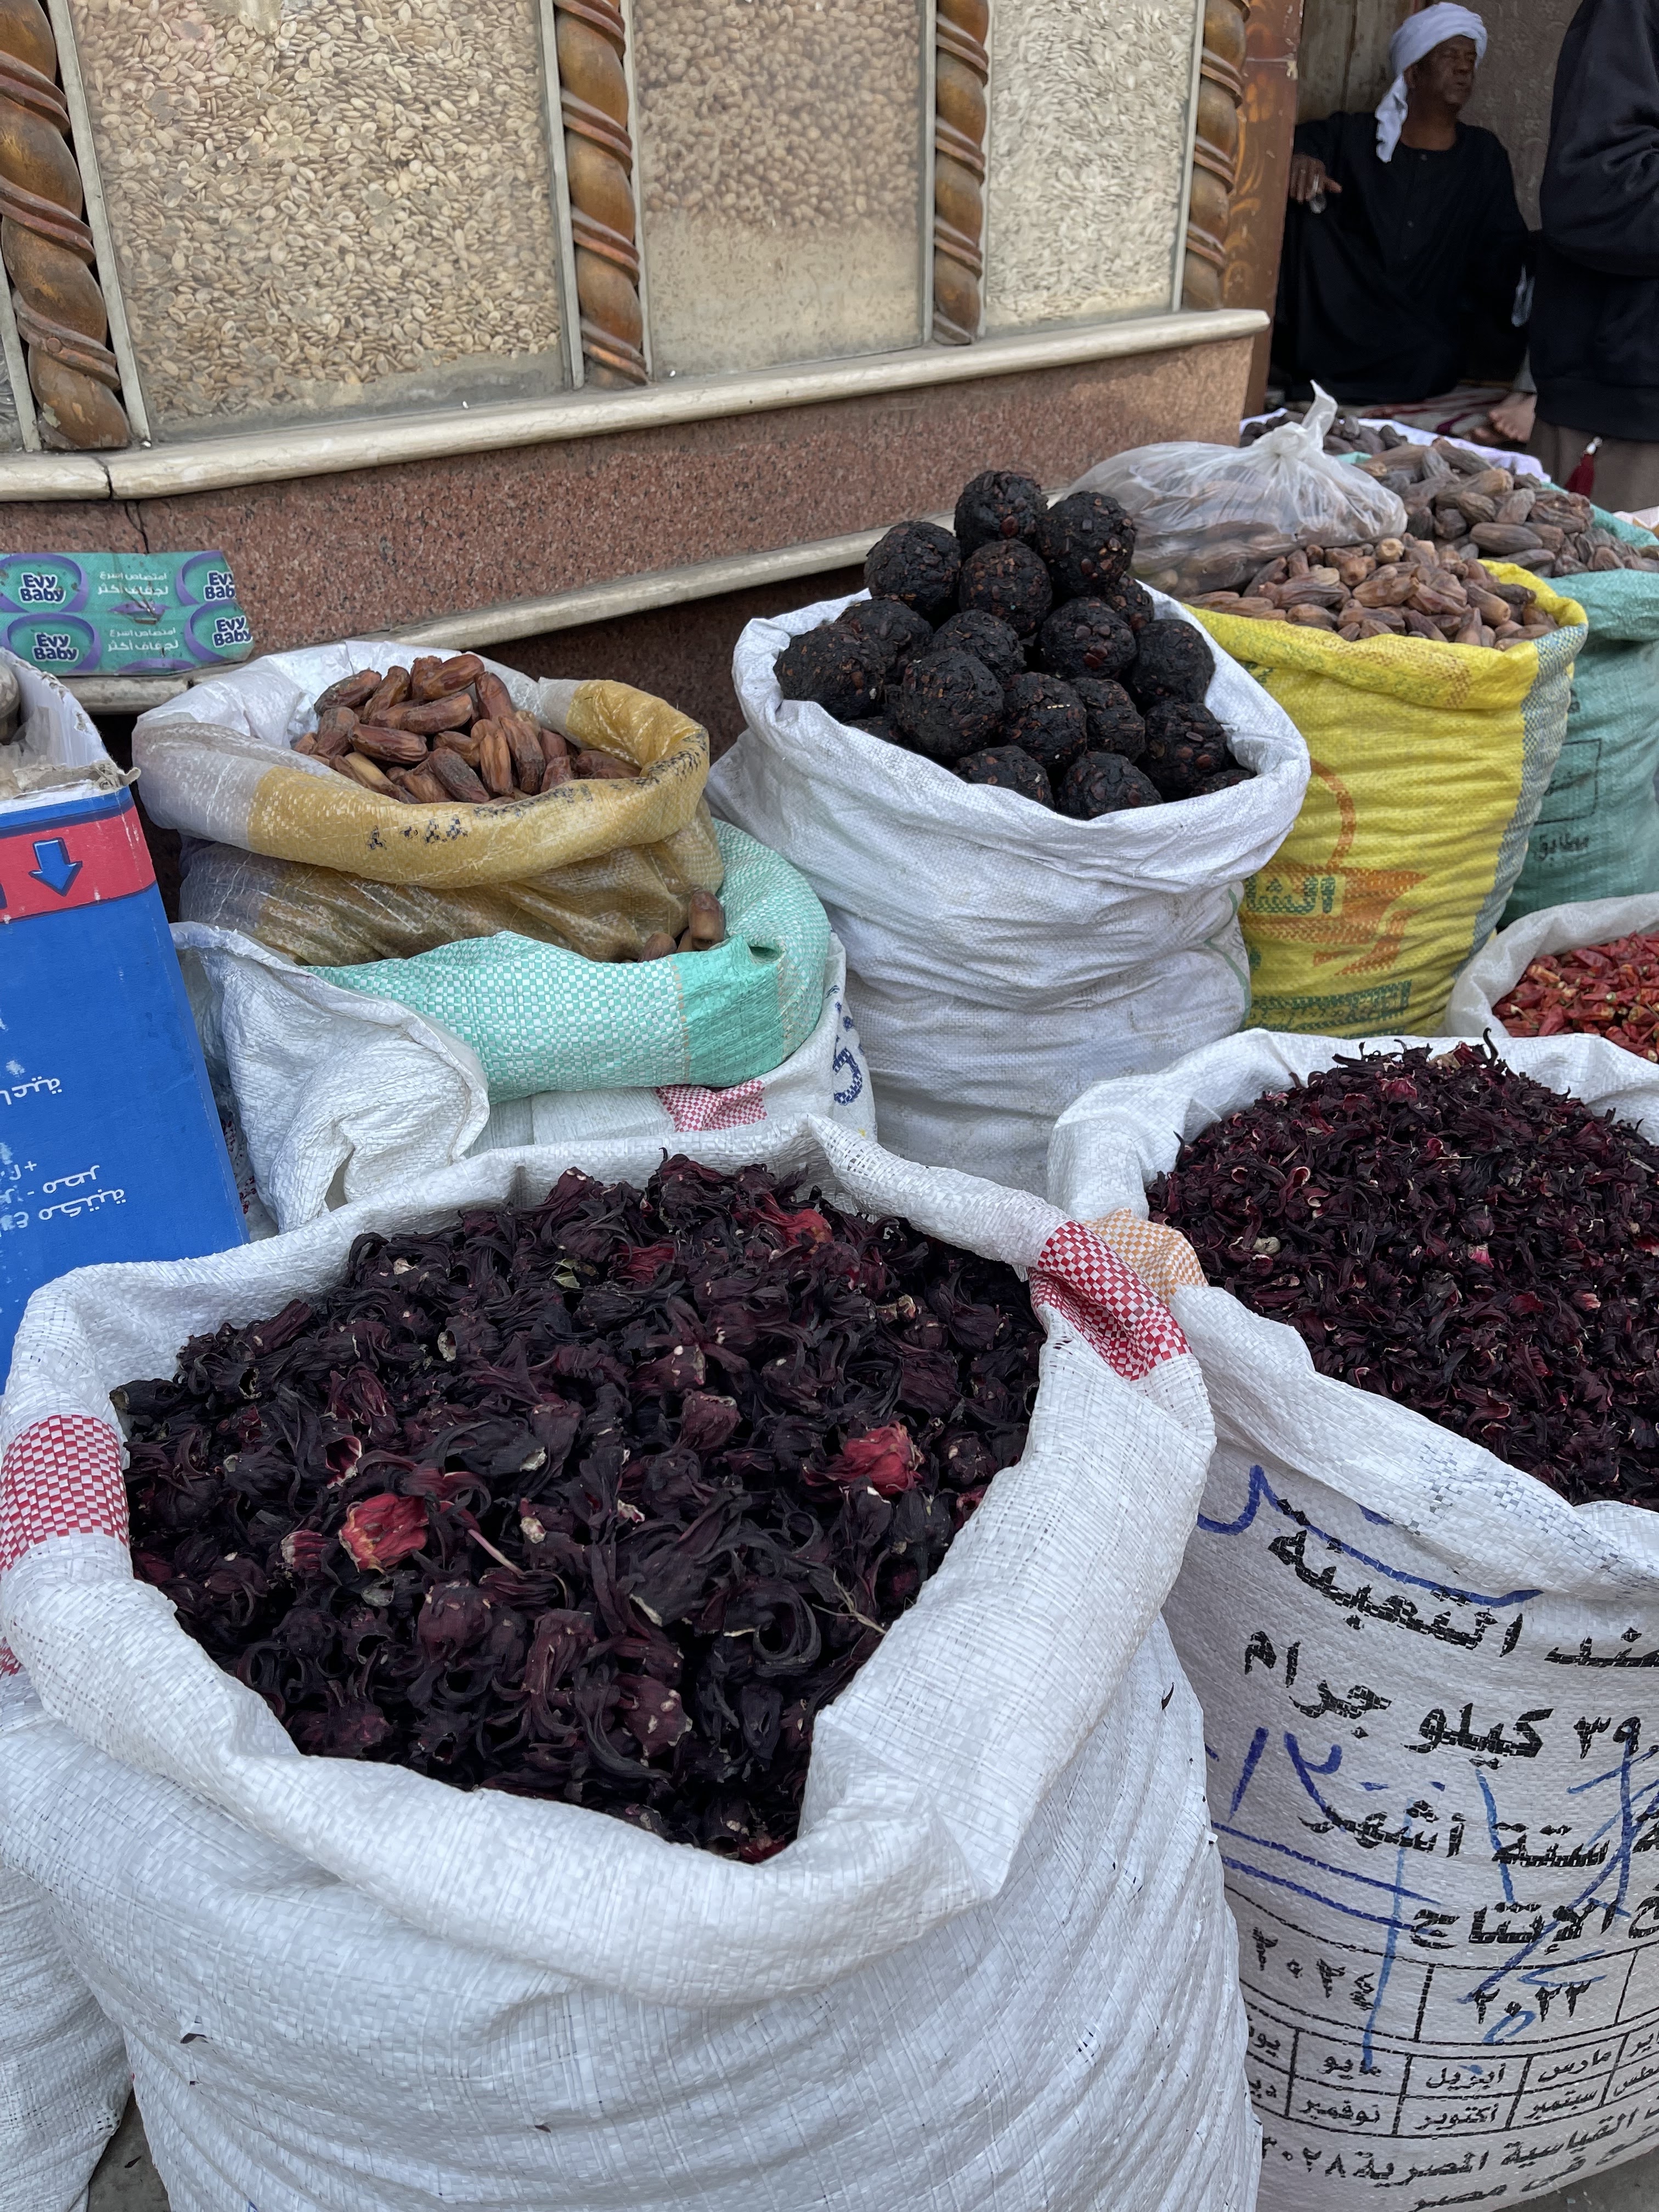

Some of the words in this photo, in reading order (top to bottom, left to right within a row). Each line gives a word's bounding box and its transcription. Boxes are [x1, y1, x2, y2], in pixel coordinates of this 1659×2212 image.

[20, 588, 65, 602] Baby
[22, 574, 56, 589] Evy
[205, 585, 235, 599] Bab
[214, 630, 252, 646] Baby
[216, 617, 245, 632] Evy
[33, 647, 77, 661] Baby
[37, 634, 69, 647] Evy
[43, 1165, 100, 1193] مصر
[38, 1189, 126, 1221] مكتبة
[1268, 1498, 1523, 1657] التعبئة
[1244, 1630, 1392, 1739] جرام
[1401, 1702, 1554, 1770] كيلو
[1297, 1799, 1467, 1858] أشهر
[1317, 2055, 1382, 2080] مايو
[1537, 2049, 1612, 2083] مارس
[1299, 2099, 1380, 2127] نوفمبر
[1523, 2090, 1598, 2121] سبتمبر
[1500, 2106, 1640, 2169] القياسية
[1352, 2150, 1489, 2188] المصرية
